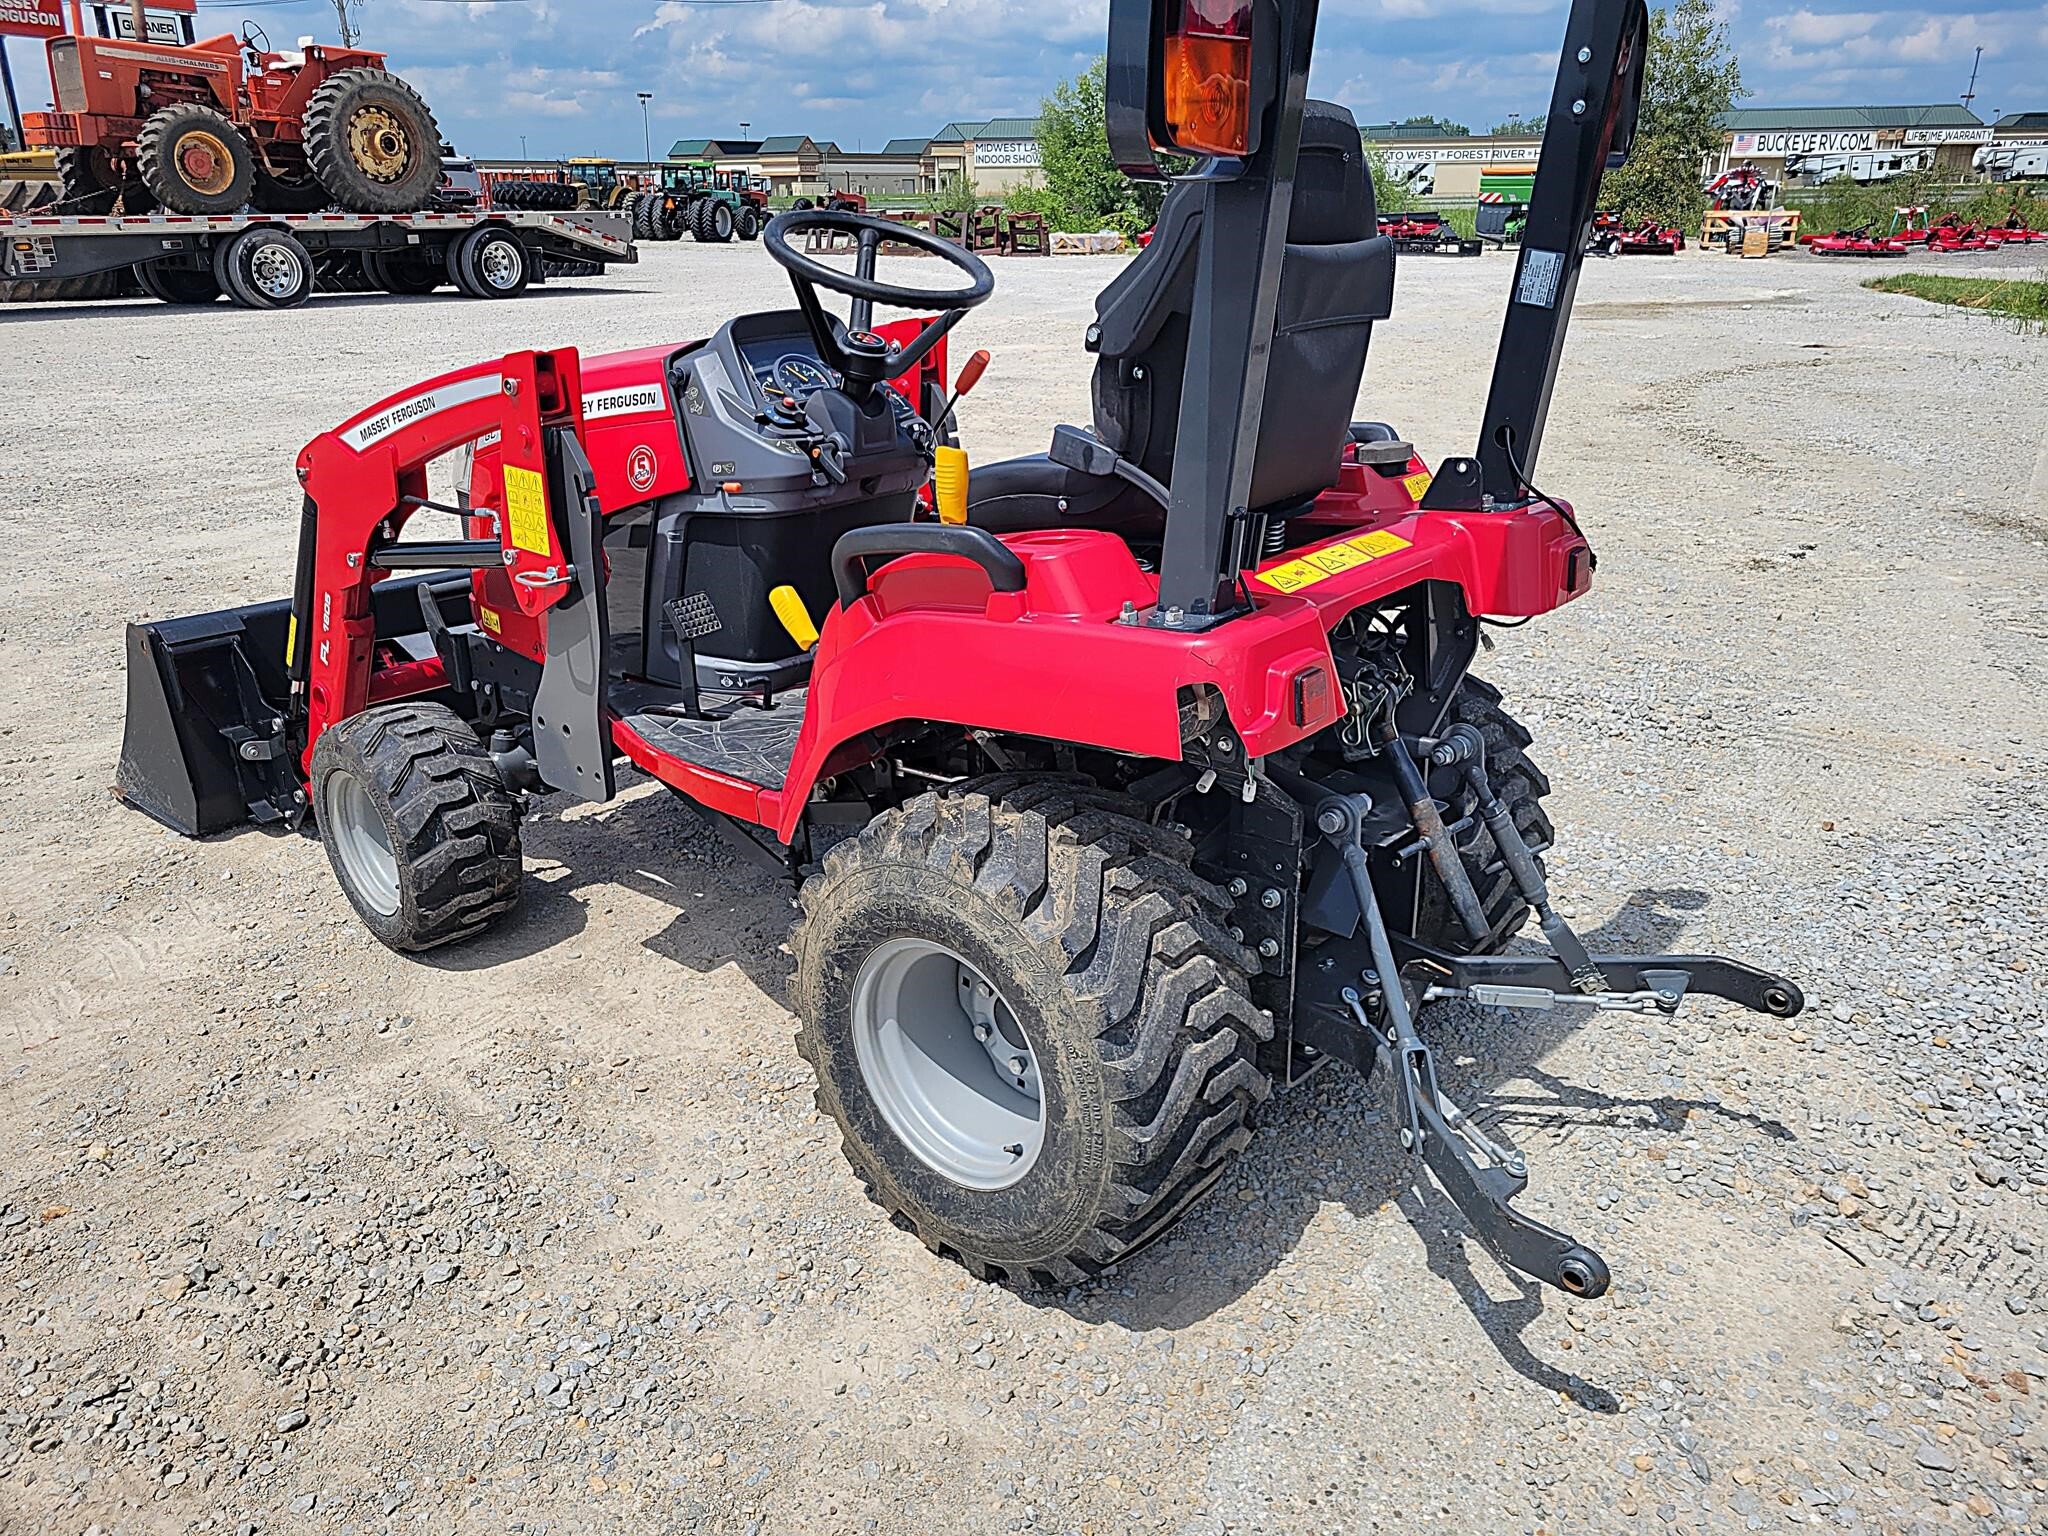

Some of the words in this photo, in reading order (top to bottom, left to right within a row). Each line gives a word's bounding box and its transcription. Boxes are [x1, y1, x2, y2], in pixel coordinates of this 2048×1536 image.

[122, 19, 176, 34] GLANER
[1907, 131, 1943, 140] LIFETIME
[1946, 130, 1994, 140] WARRANTY
[975, 143, 1022, 153] MIDWEST
[975, 154, 1011, 164] INDOOR
[1407, 151, 1439, 160] WEST
[1446, 150, 1490, 160] FOREST
[1492, 149, 1526, 159] RIVER
[597, 391, 657, 412] FERGUSON
[359, 415, 391, 443] MASSEY
[391, 395, 437, 425] FERGUSON
